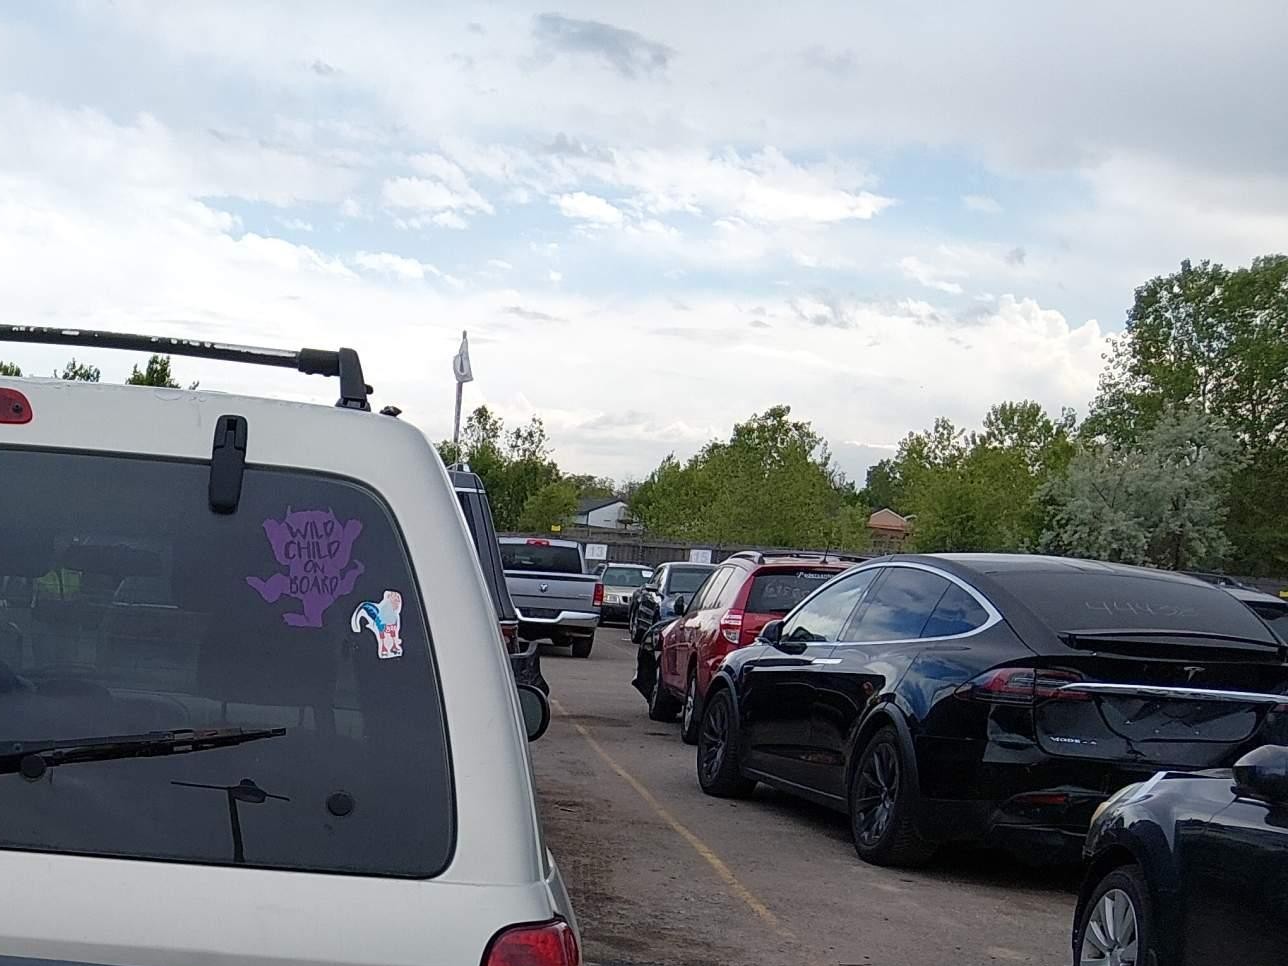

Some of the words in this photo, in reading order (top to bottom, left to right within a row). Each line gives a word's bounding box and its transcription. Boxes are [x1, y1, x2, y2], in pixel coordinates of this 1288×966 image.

[285, 520, 335, 540] WILD
[285, 540, 340, 560] CHILD
[304, 560, 325, 574] ON
[289, 576, 338, 594] BOARD
[1050, 736, 1088, 745] MODE
